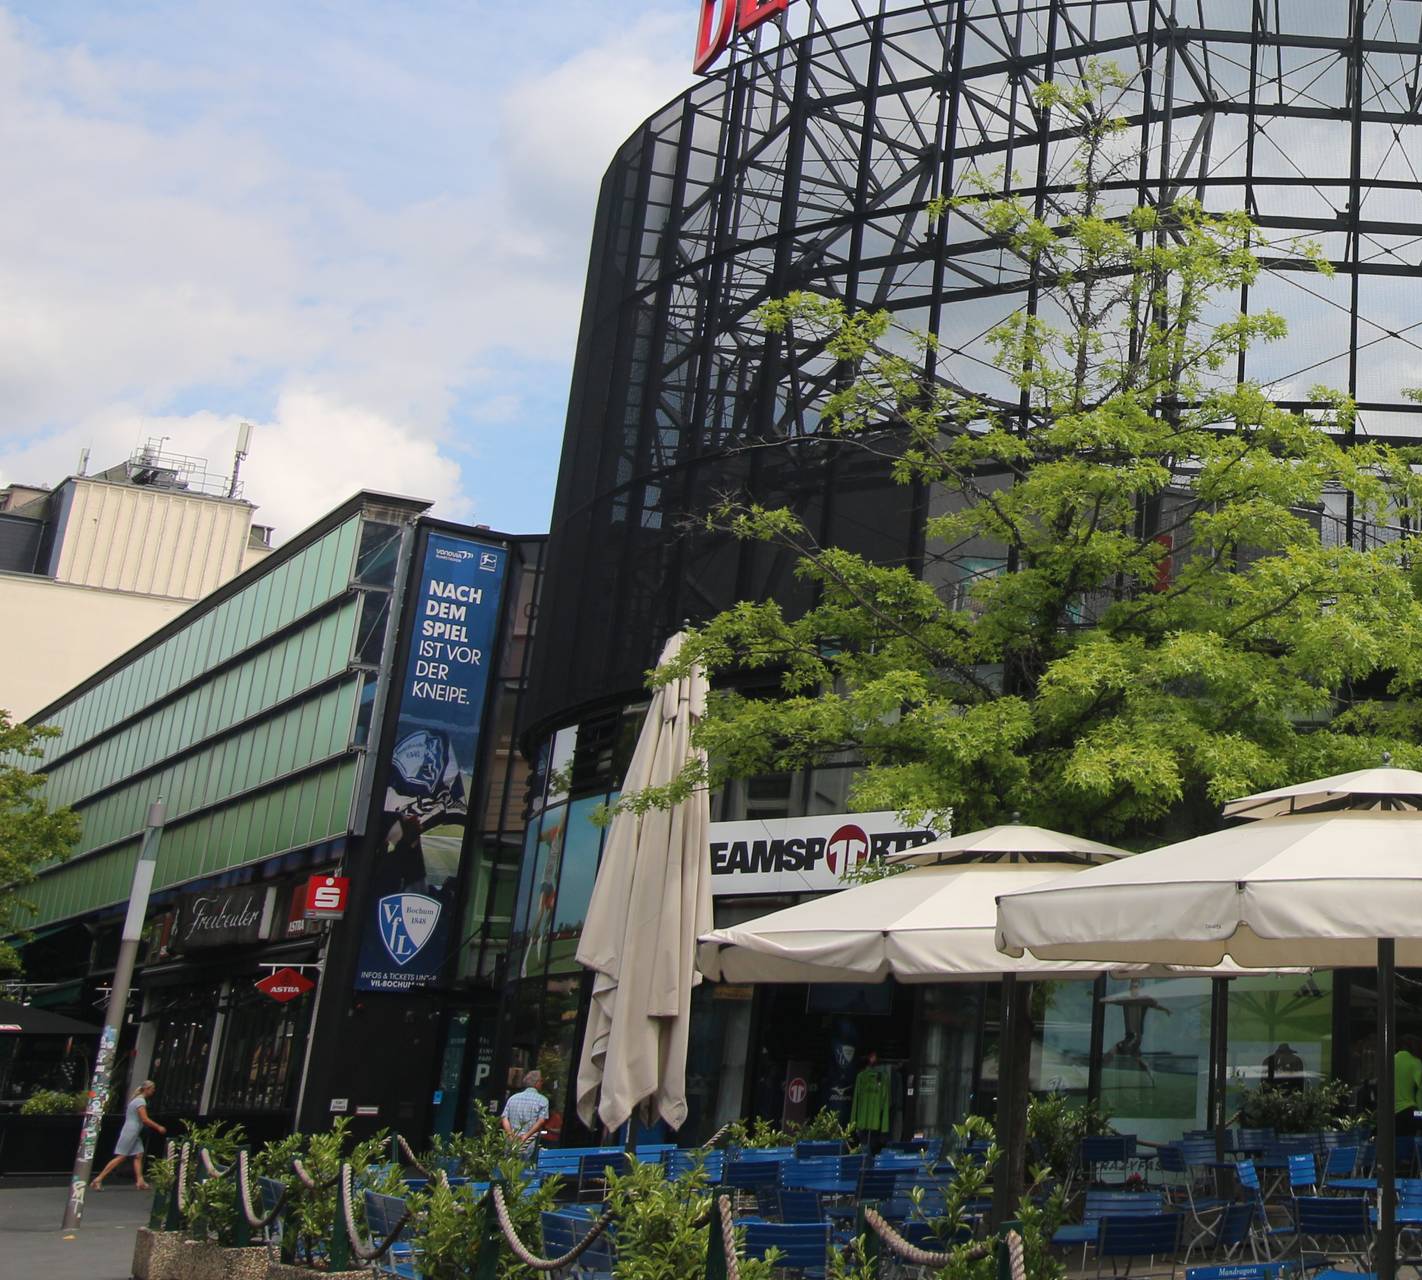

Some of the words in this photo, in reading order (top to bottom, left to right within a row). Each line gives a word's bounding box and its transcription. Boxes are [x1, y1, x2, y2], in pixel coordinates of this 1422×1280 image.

[429, 580, 482, 604] NACH
[425, 600, 466, 621] DEM
[422, 620, 468, 642] SPIEL
[419, 640, 444, 658] IST
[447, 644, 481, 665] VOR
[415, 660, 449, 680] DER
[412, 680, 469, 704] KNEIPE.
[361, 971, 382, 979] INFOS
[390, 972, 415, 981] TICKETS
